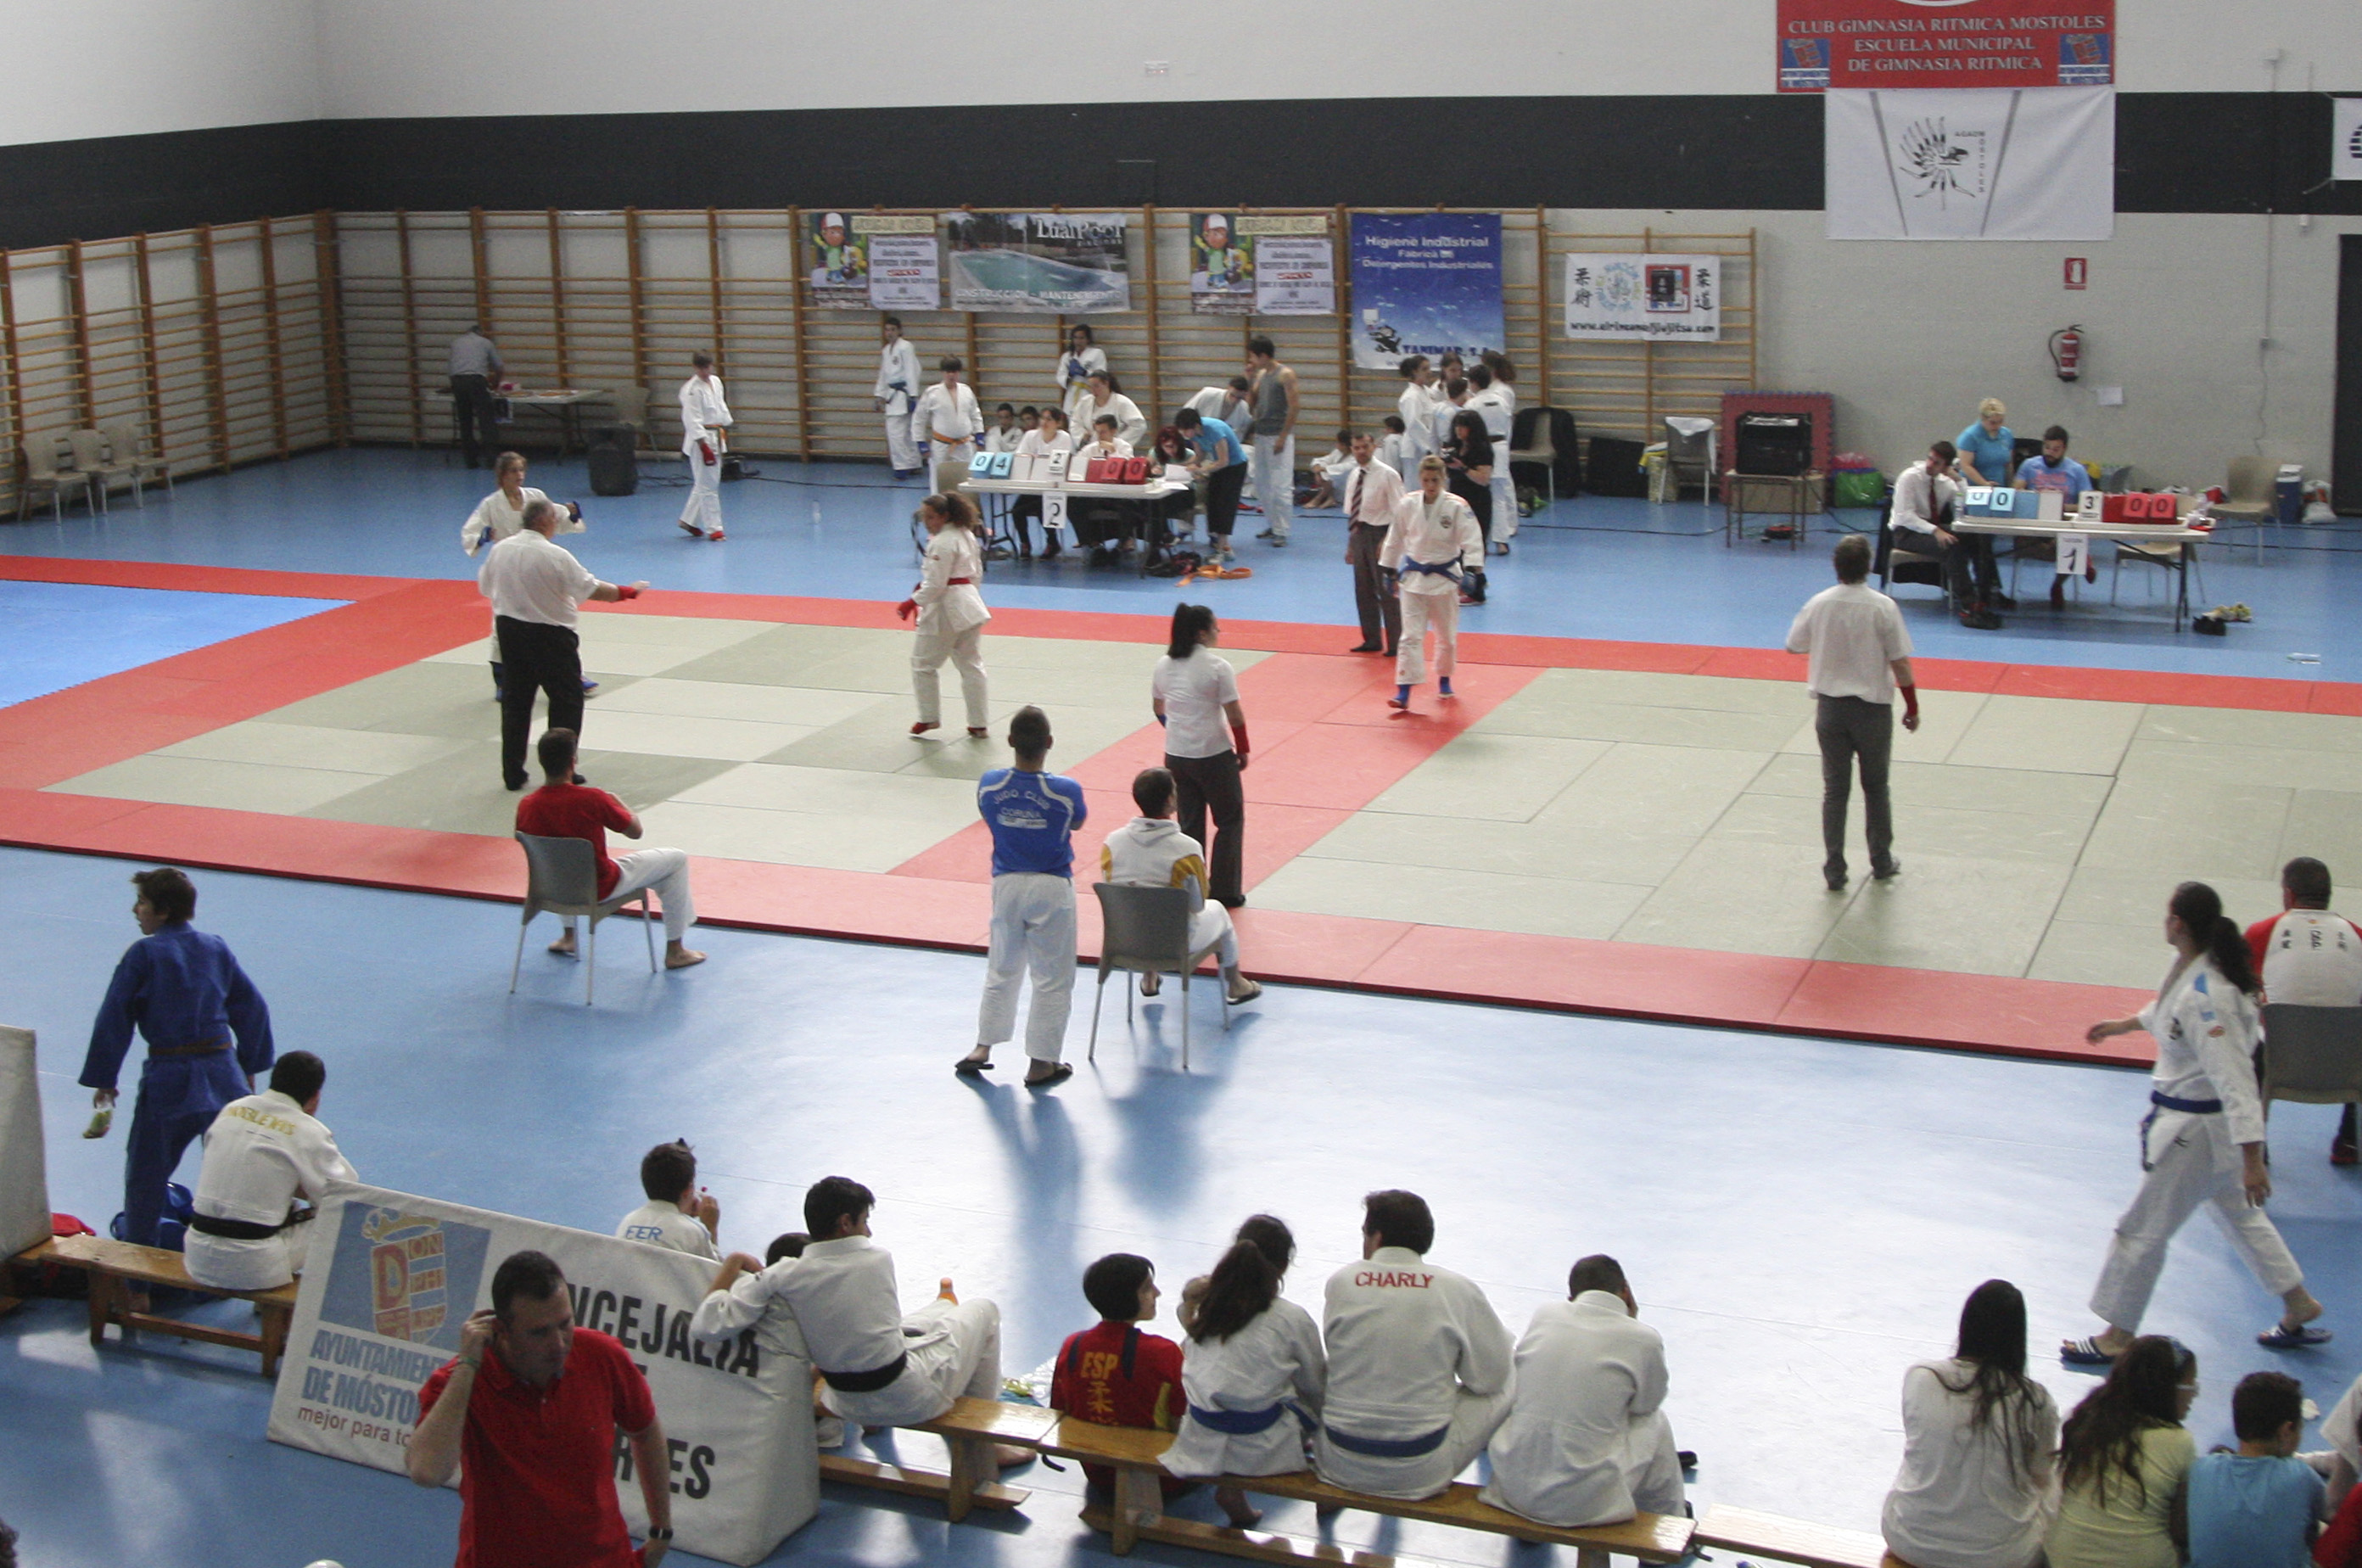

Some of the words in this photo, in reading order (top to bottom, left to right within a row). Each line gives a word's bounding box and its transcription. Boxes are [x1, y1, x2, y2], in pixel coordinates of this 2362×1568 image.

[1788, 20, 1835, 34] CLUB
[1839, 19, 1926, 33] GIMNASIA
[1930, 17, 2005, 31] RITMICA
[2009, 15, 2106, 30] MOSTOLES
[1854, 38, 1933, 52] ESCUELA
[1938, 36, 2036, 51] MUNICIPAL
[1848, 59, 1871, 72] DE
[1874, 57, 1962, 71] GIMNASIA
[1967, 56, 2043, 70] RITMICA
[1365, 235, 1419, 249] Higiene
[1421, 236, 1489, 247] Industrial
[995, 456, 1008, 470] 4
[1997, 492, 2008, 506] 0
[2130, 498, 2142, 512] 0
[2156, 499, 2168, 512] 0
[1048, 502, 1061, 526] 2
[2063, 548, 2076, 572] 1
[625, 1224, 663, 1241] FER
[1355, 1272, 1434, 1289] CHARLY
[1081, 1351, 1119, 1380] ESP
[302, 1366, 333, 1404] DE
[333, 1373, 422, 1425] MÓSTO
[298, 1407, 348, 1431] mejor
[350, 1420, 390, 1442] para
